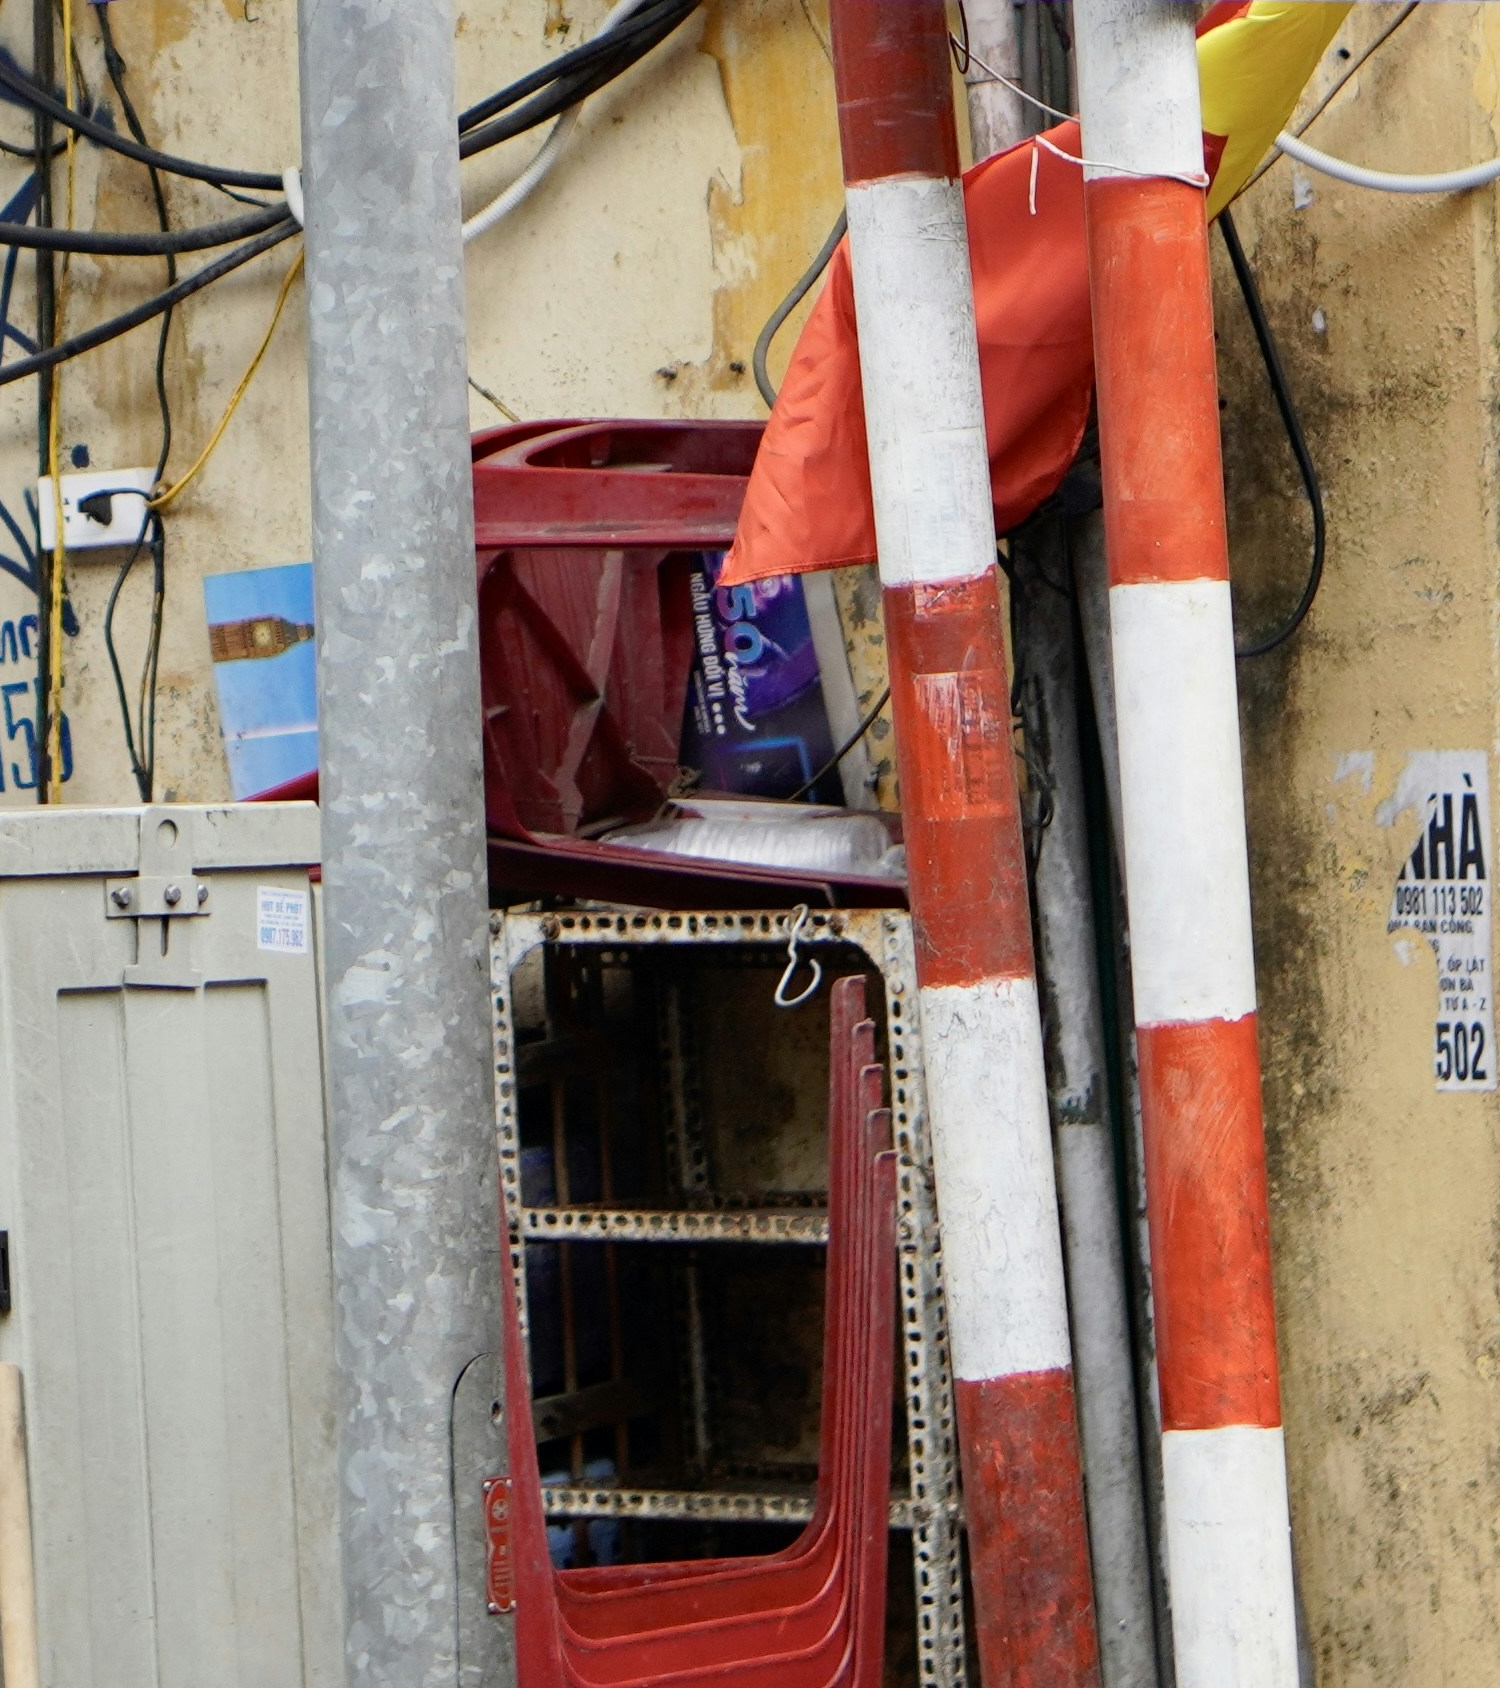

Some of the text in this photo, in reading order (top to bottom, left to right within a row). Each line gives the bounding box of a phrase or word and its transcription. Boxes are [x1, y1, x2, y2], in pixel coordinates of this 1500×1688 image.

[1432, 886, 1456, 915] 113
[1460, 886, 1483, 915] 502
[1436, 1021, 1487, 1081] 502
